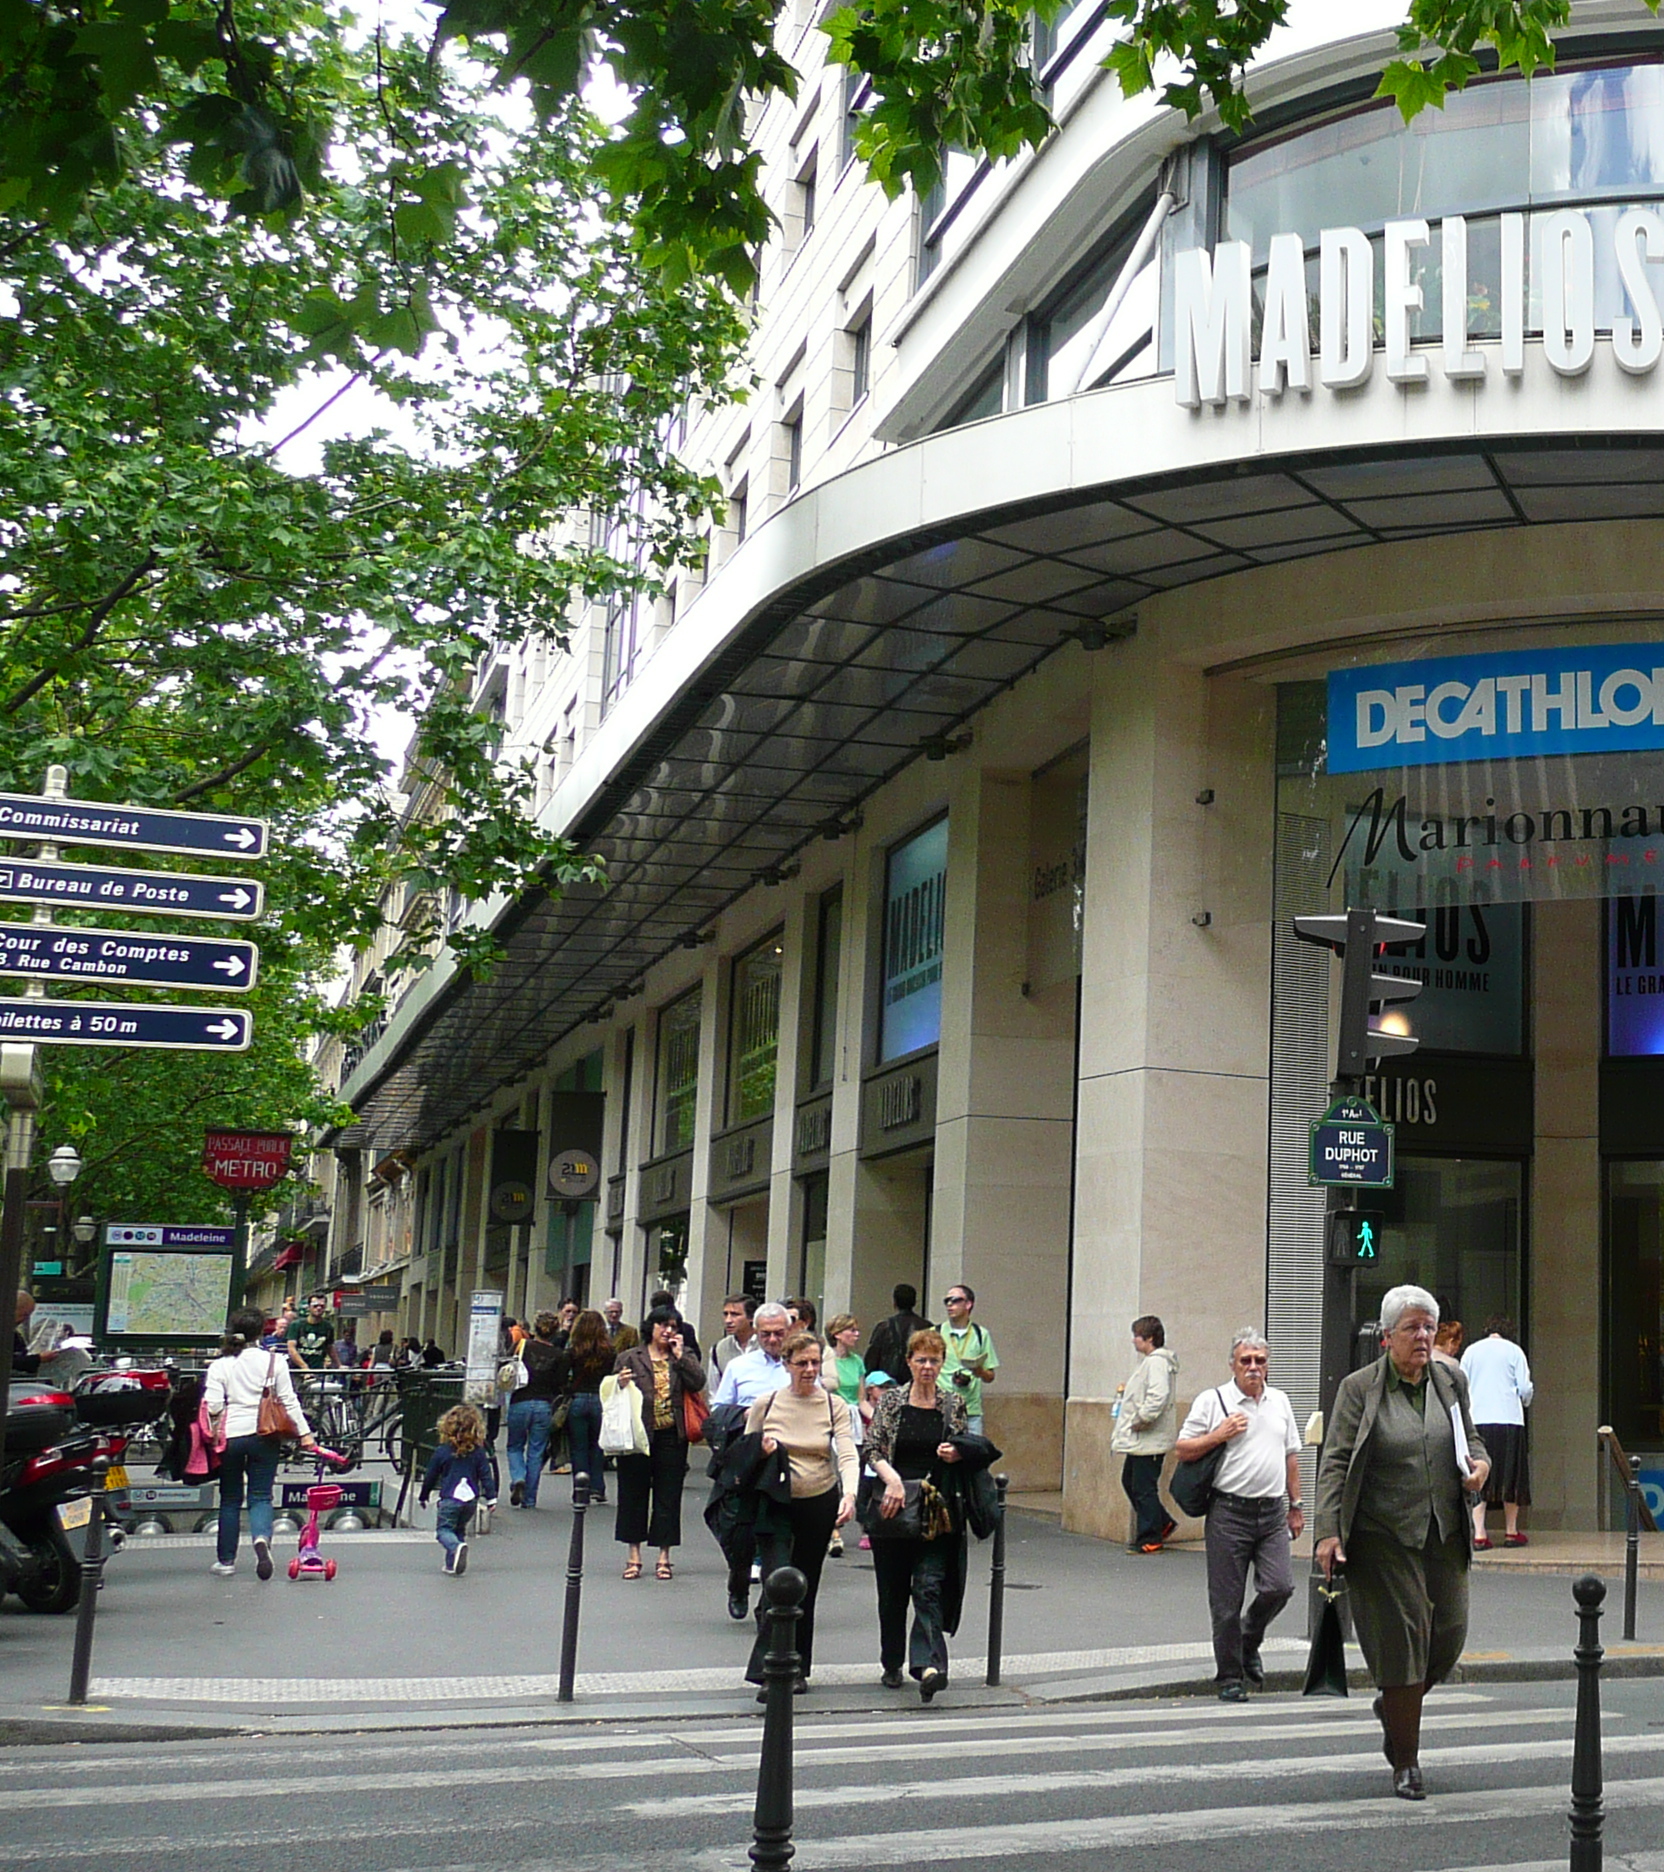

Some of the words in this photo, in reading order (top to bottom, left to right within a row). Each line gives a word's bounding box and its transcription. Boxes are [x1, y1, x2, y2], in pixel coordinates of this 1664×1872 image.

[1175, 209, 1664, 408] MADELIOS
[0, 806, 140, 836] Commissariat
[18, 873, 92, 894] Bureau
[100, 881, 124, 897] de
[132, 883, 189, 902] Poste
[53, 937, 89, 955] des
[101, 941, 190, 963] Comptes
[18, 955, 51, 969] Rue
[60, 958, 127, 975] Cambon
[1435, 967, 1490, 992] HOMME
[1616, 976, 1632, 995] LE
[70, 1016, 82, 1031] à
[90, 1016, 117, 1032] 50
[120, 1020, 137, 1033] m
[1338, 1131, 1366, 1146] RUE
[1324, 1147, 1379, 1163] DUPHOT
[214, 1159, 277, 1178] METRO
[170, 1232, 226, 1243] Madeleine
